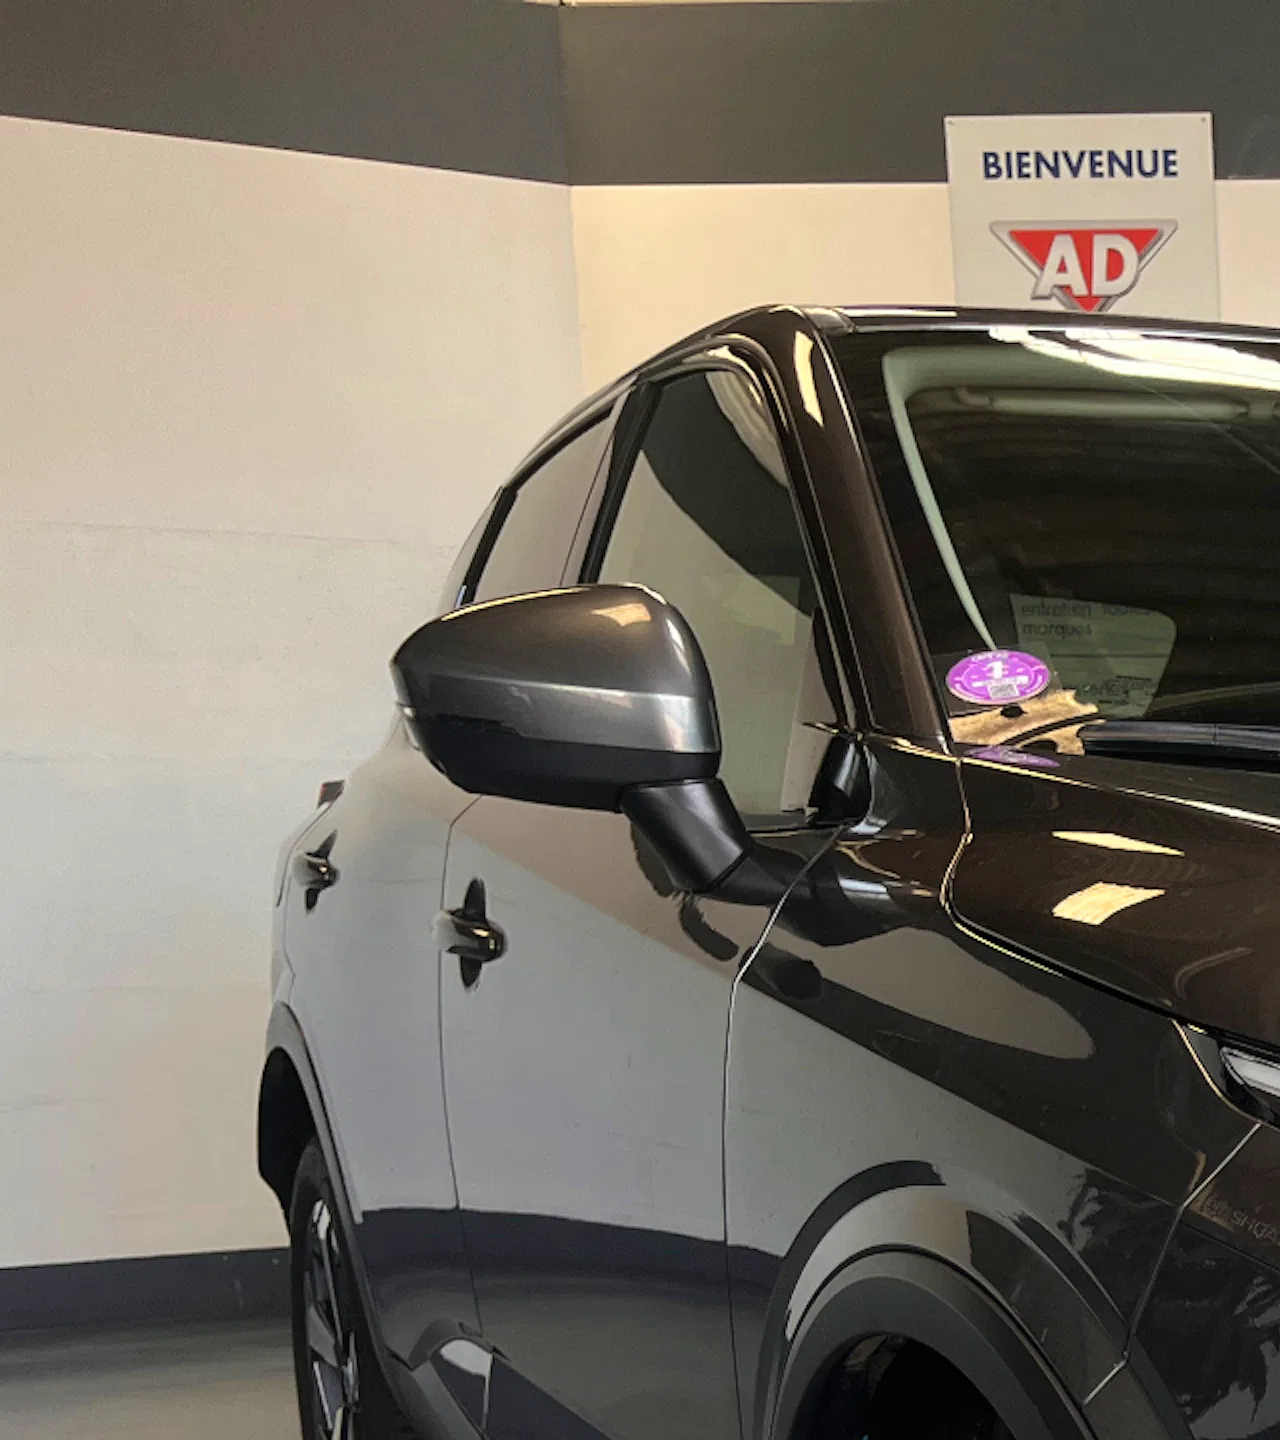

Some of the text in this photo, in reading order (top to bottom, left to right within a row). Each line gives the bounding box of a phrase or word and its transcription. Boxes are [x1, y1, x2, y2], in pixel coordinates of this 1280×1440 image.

[983, 149, 1178, 180] BIENVENUE
[1031, 233, 1140, 299] AD
[1022, 622, 1093, 640] marques
